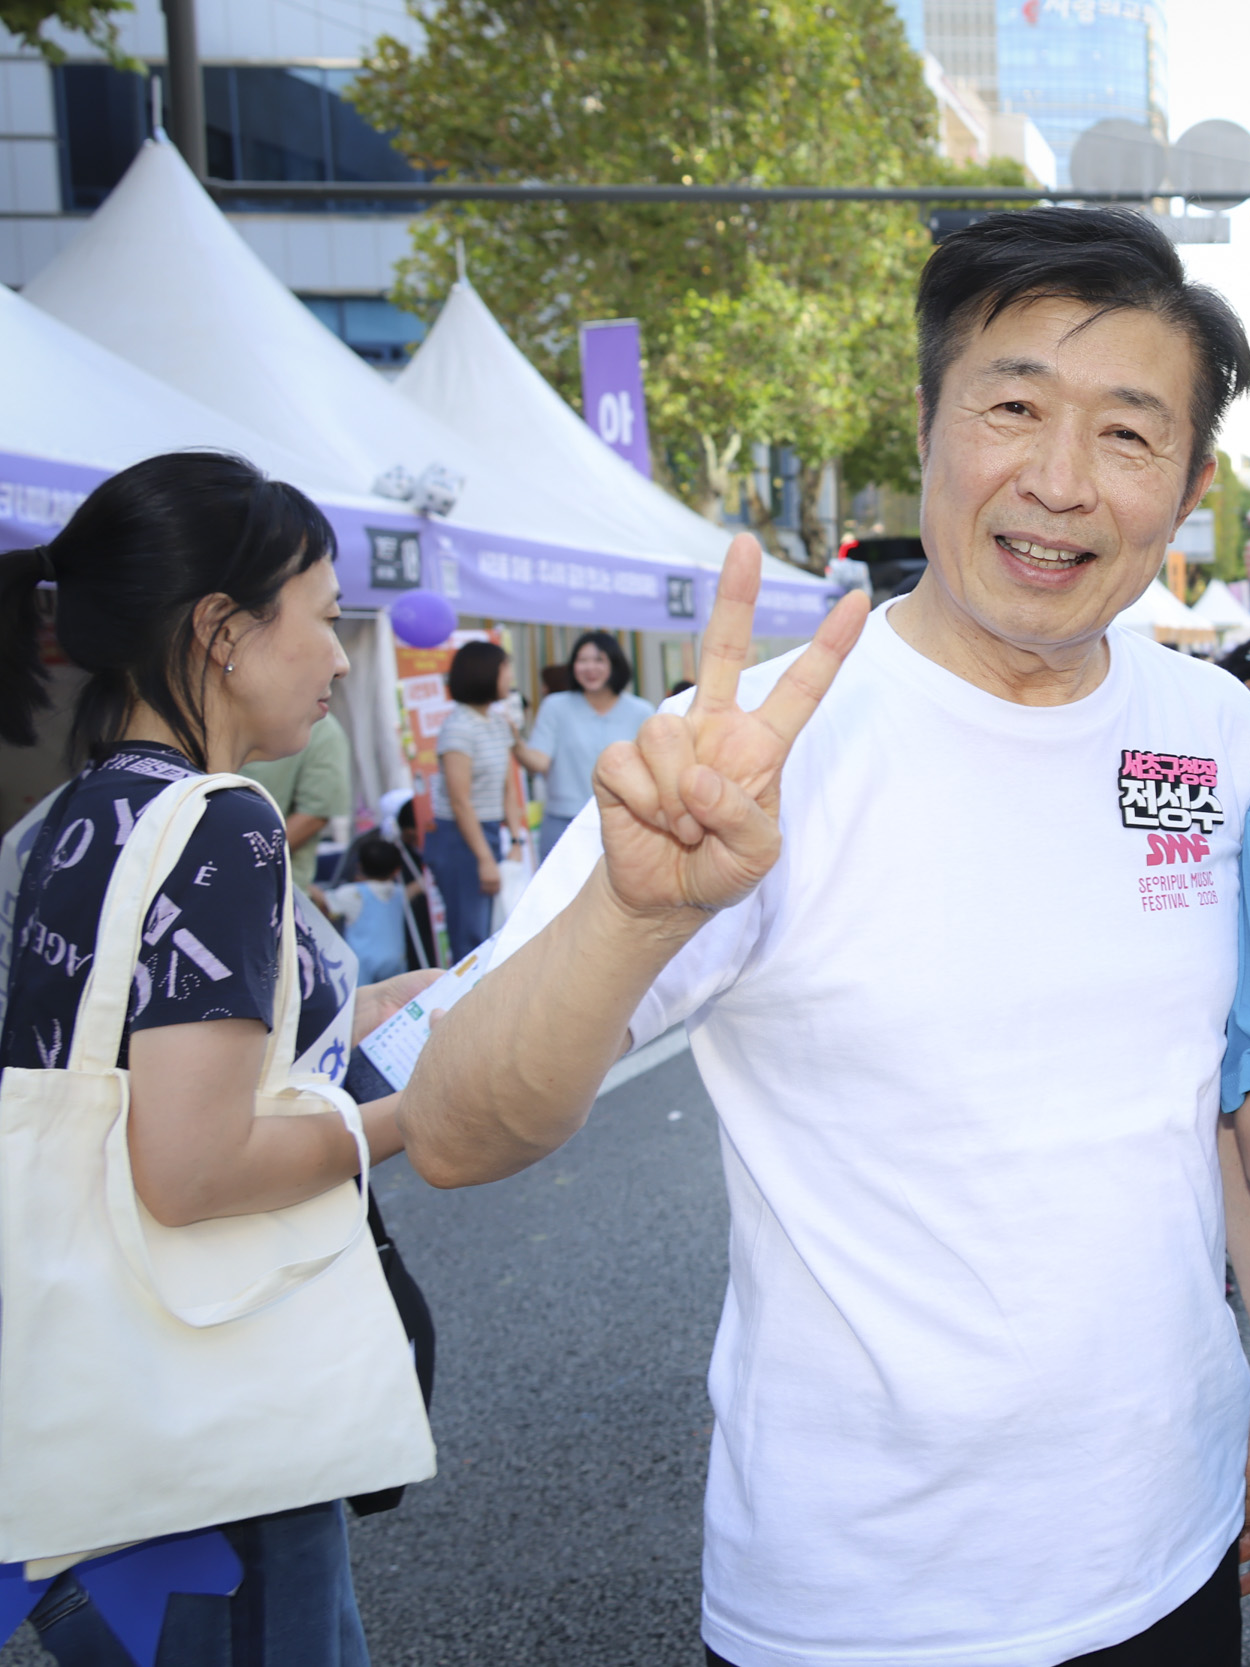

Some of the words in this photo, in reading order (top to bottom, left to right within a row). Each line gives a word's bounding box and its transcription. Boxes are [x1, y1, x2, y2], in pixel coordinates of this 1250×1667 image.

[1122, 752, 1218, 787] 서초구청장
[1121, 779, 1224, 831] 전성수
[1191, 871, 1214, 888] MUSIC
[1141, 893, 1190, 912] FESTIVAL
